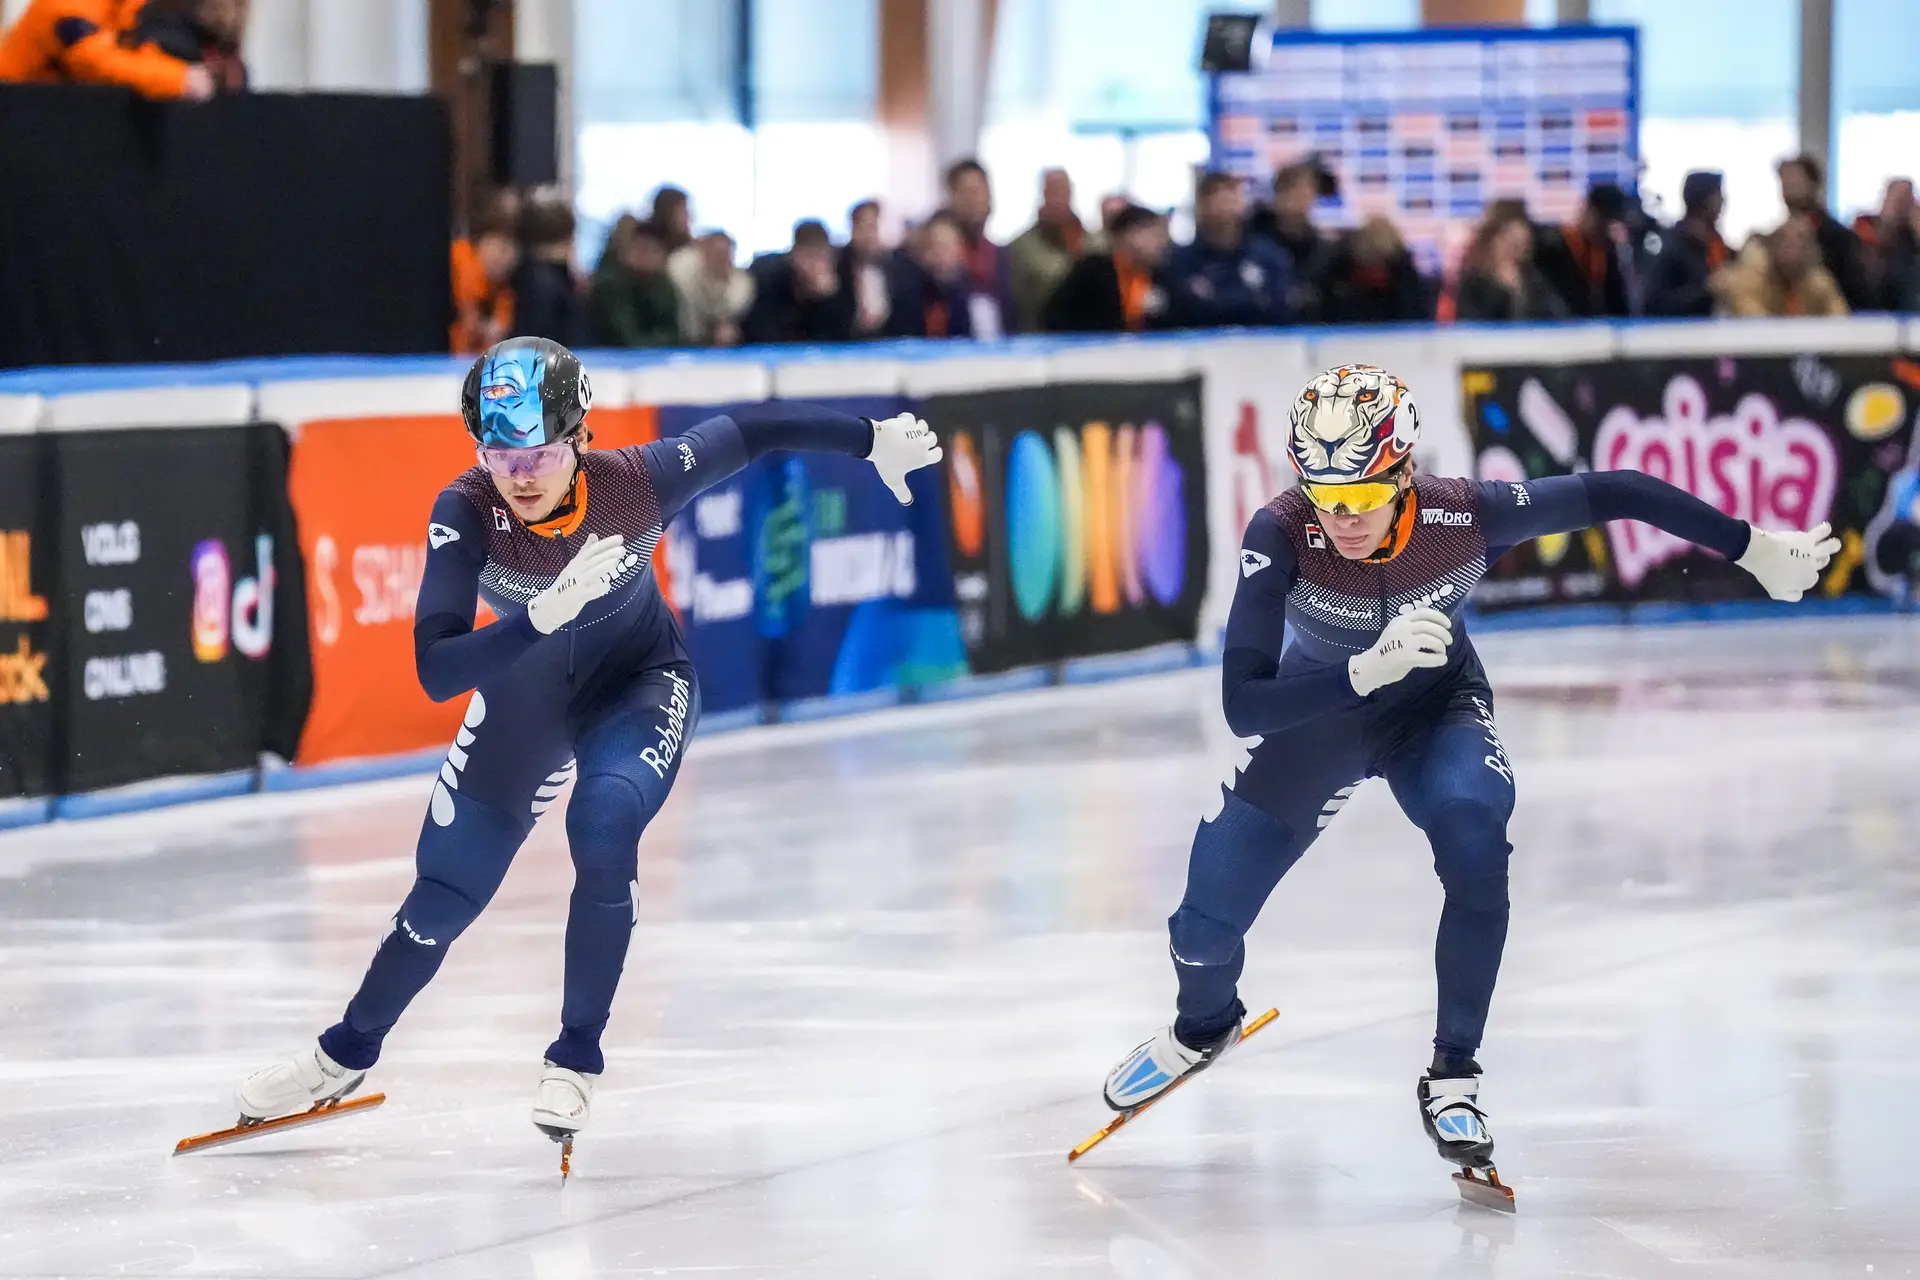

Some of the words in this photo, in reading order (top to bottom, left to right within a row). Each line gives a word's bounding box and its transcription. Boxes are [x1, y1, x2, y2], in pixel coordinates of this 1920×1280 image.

[1408, 402, 1419, 431] 2
[1422, 510, 1472, 525] WADRO
[1307, 595, 1375, 620] Rabobank
[640, 670, 689, 779] Rabobank
